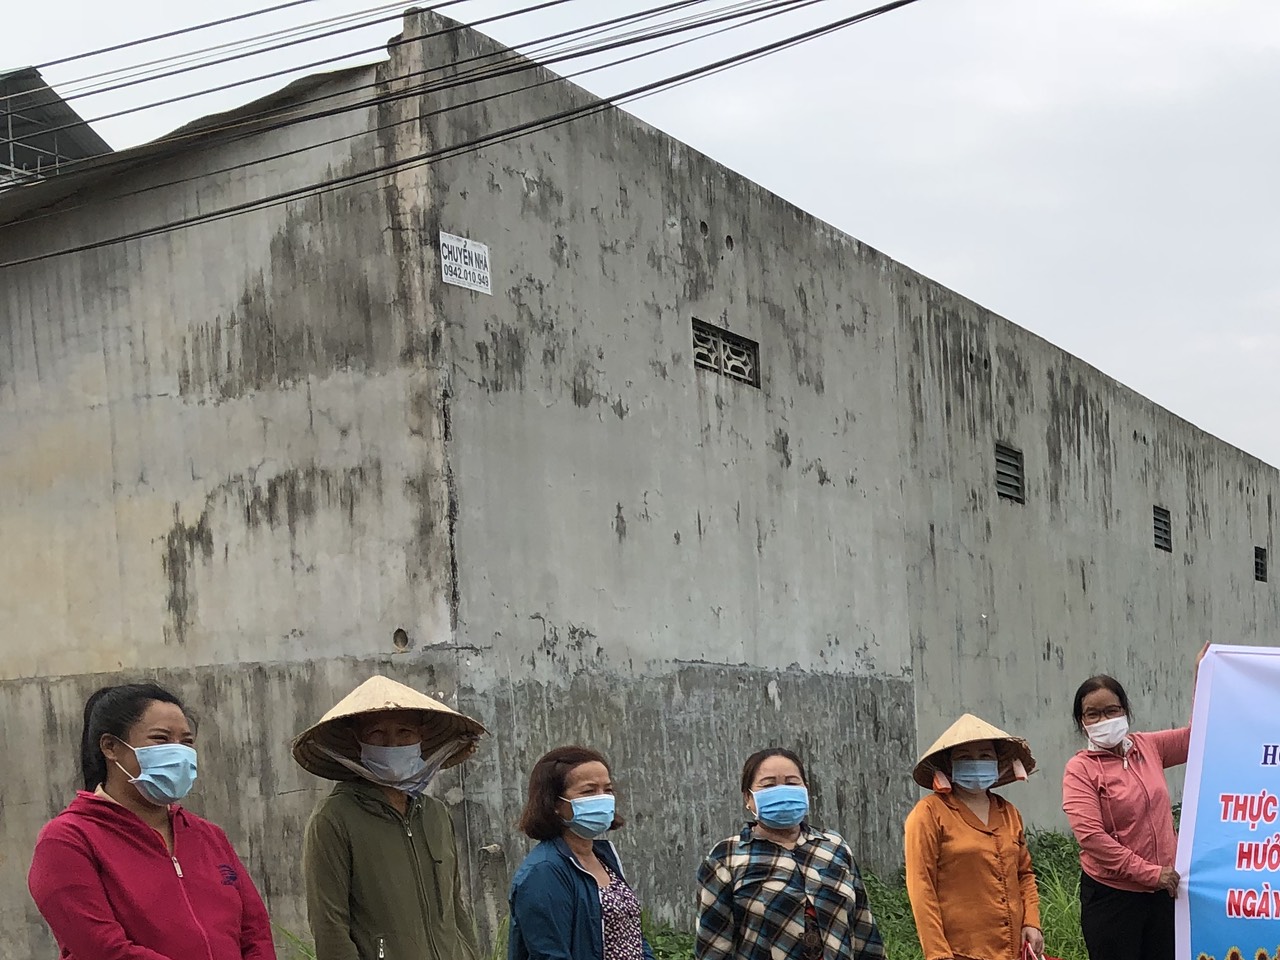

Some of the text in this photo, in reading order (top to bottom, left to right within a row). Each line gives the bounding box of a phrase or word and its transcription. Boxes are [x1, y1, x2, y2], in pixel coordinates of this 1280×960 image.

[442, 240, 473, 267] CHUYỂN
[474, 251, 488, 272] NHÀ
[1220, 790, 1278, 829] THỰC
